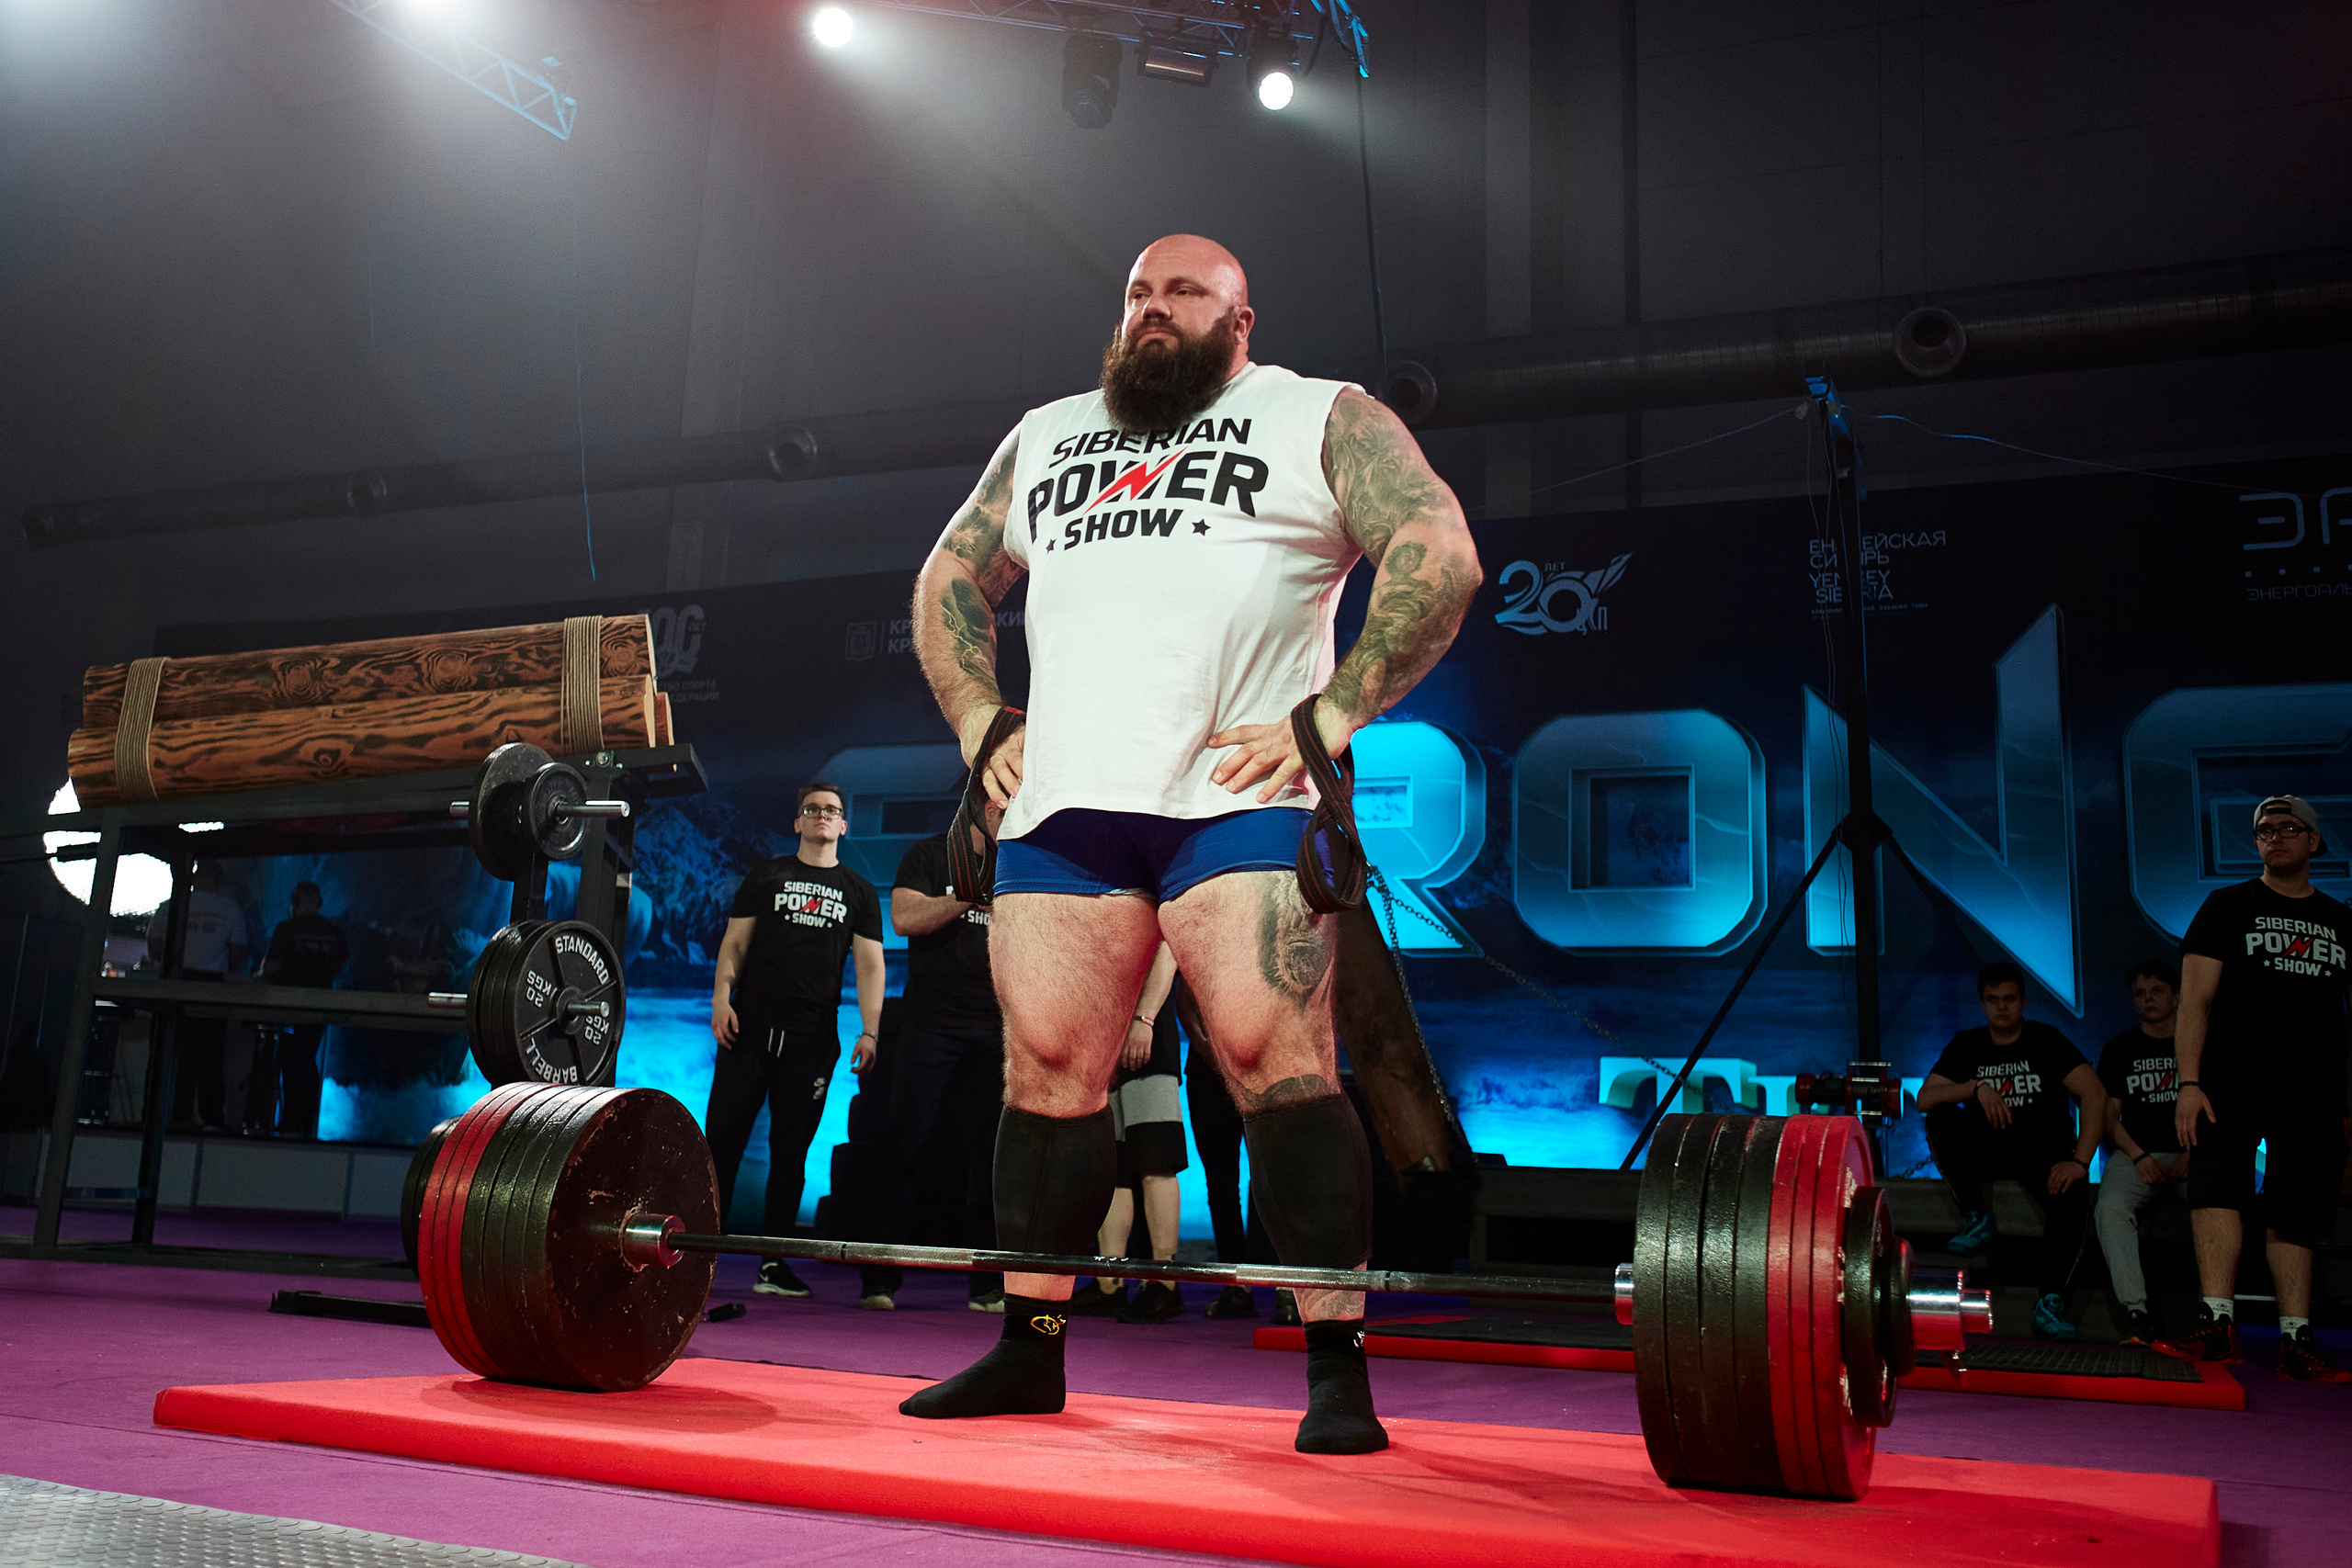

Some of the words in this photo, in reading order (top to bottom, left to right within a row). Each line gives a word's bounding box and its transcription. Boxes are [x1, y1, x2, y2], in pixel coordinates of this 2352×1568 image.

[1048, 418, 1251, 469] SIBERIAN
[1027, 450, 1269, 544] POWER
[1064, 508, 1183, 551] SHOW
[1809, 530, 1947, 555] ЕНЕЙСКАЯ
[1544, 561, 1566, 572] ЛЕТ
[1809, 549, 1890, 570] СИРЬ
[1815, 583, 1894, 604] SIBRIA
[784, 880, 842, 902] SIBERIAN
[775, 893, 848, 923] POWER
[791, 912, 827, 929] SHOW
[967, 909, 991, 926] SHO
[2255, 917, 2336, 942] SIBERIAN
[555, 934, 610, 986] STANDARD
[2245, 931, 2346, 971] POWER
[2274, 957, 2323, 977] SHOW
[526, 969, 552, 997] KGS
[526, 1035, 579, 1085] BARBELL
[1983, 1073, 2042, 1097] OWER
[2126, 1070, 2179, 1096] POW
[2003, 1096, 2025, 1108] OW
